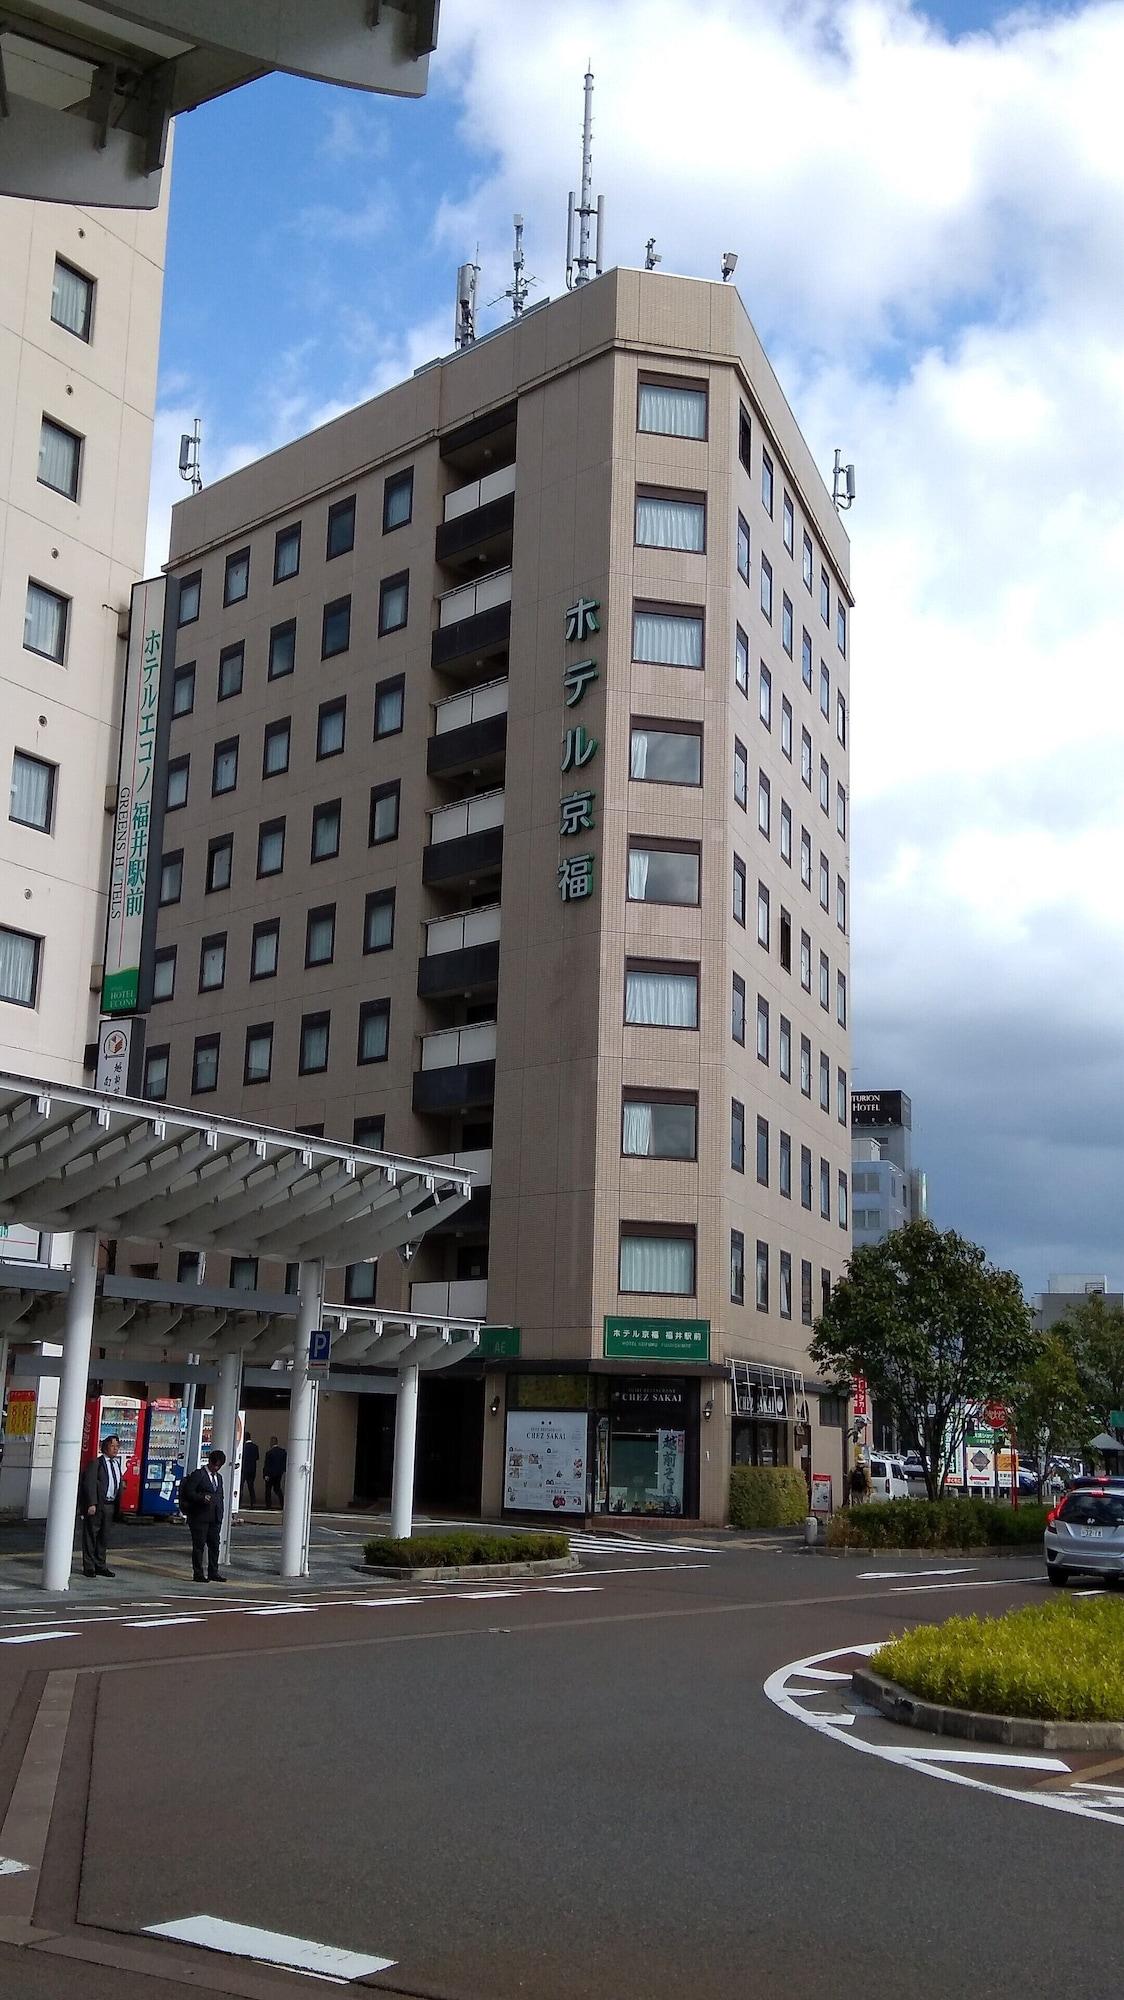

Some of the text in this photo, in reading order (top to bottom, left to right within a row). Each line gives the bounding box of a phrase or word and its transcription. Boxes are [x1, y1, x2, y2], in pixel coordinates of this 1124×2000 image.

[558, 598, 599, 901] ホテル京福
[126, 630, 161, 917] ホテルエコノ 福井駅前
[115, 786, 130, 851] GREENS
[110, 989, 134, 1000] HOTEL
[852, 1103, 880, 1111] HOTEL
[613, 1329, 702, 1341] ホテル京福 福井駅前
[313, 1333, 327, 1358] P
[622, 1393, 682, 1402] CHEZ SAKAI
[526, 1432, 567, 1440] CHEZ SAKAI
